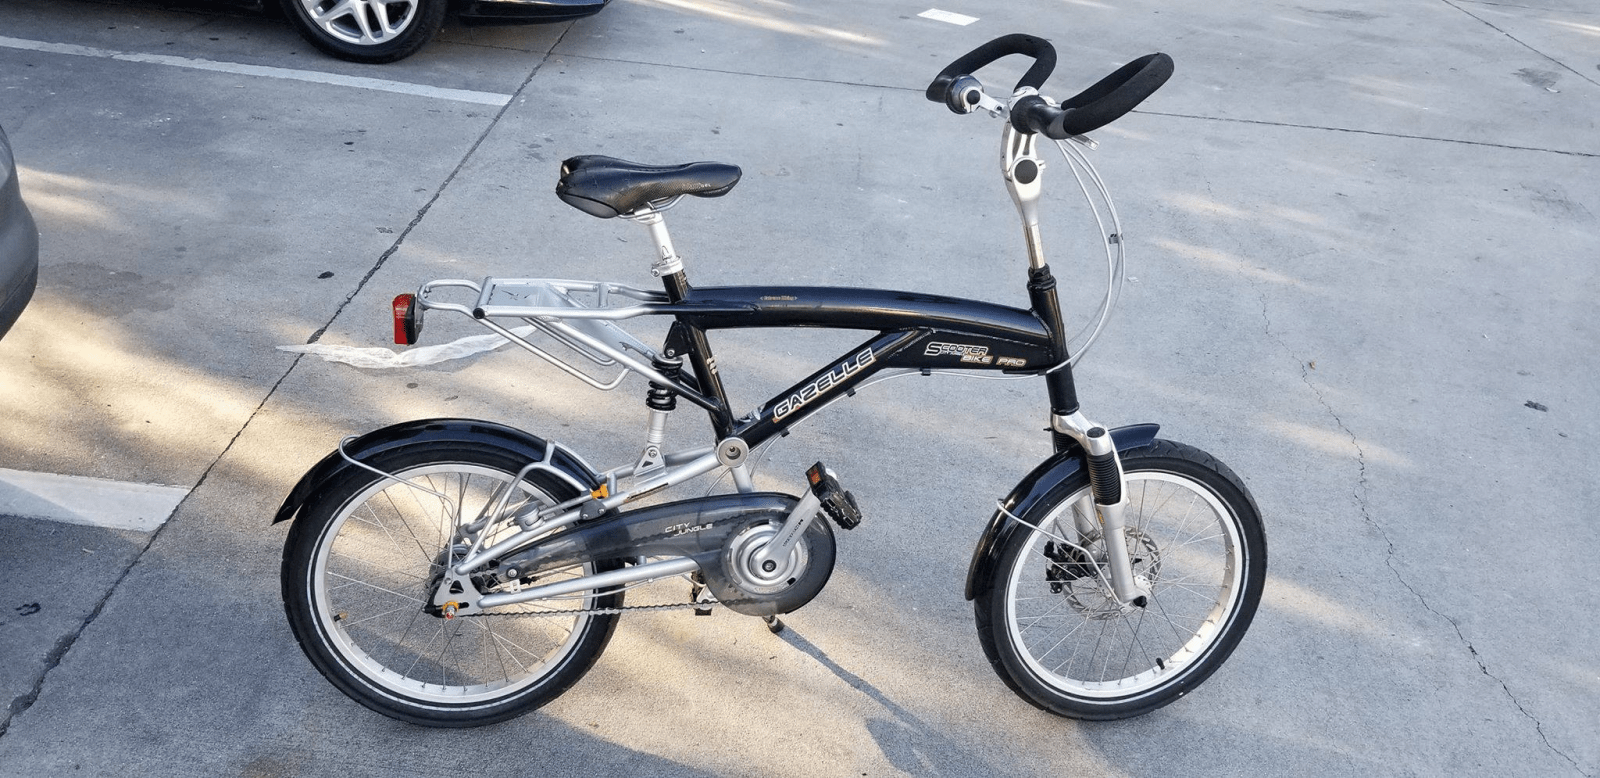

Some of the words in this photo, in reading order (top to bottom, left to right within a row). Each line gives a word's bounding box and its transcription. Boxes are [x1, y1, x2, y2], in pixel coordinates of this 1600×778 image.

[924, 341, 989, 356] SCOOTER
[961, 355, 994, 364] BIKE
[996, 356, 1027, 367] PRO
[773, 347, 875, 420] GAZELLE
[665, 522, 691, 533] CITY
[673, 523, 713, 537] JUNGLE
